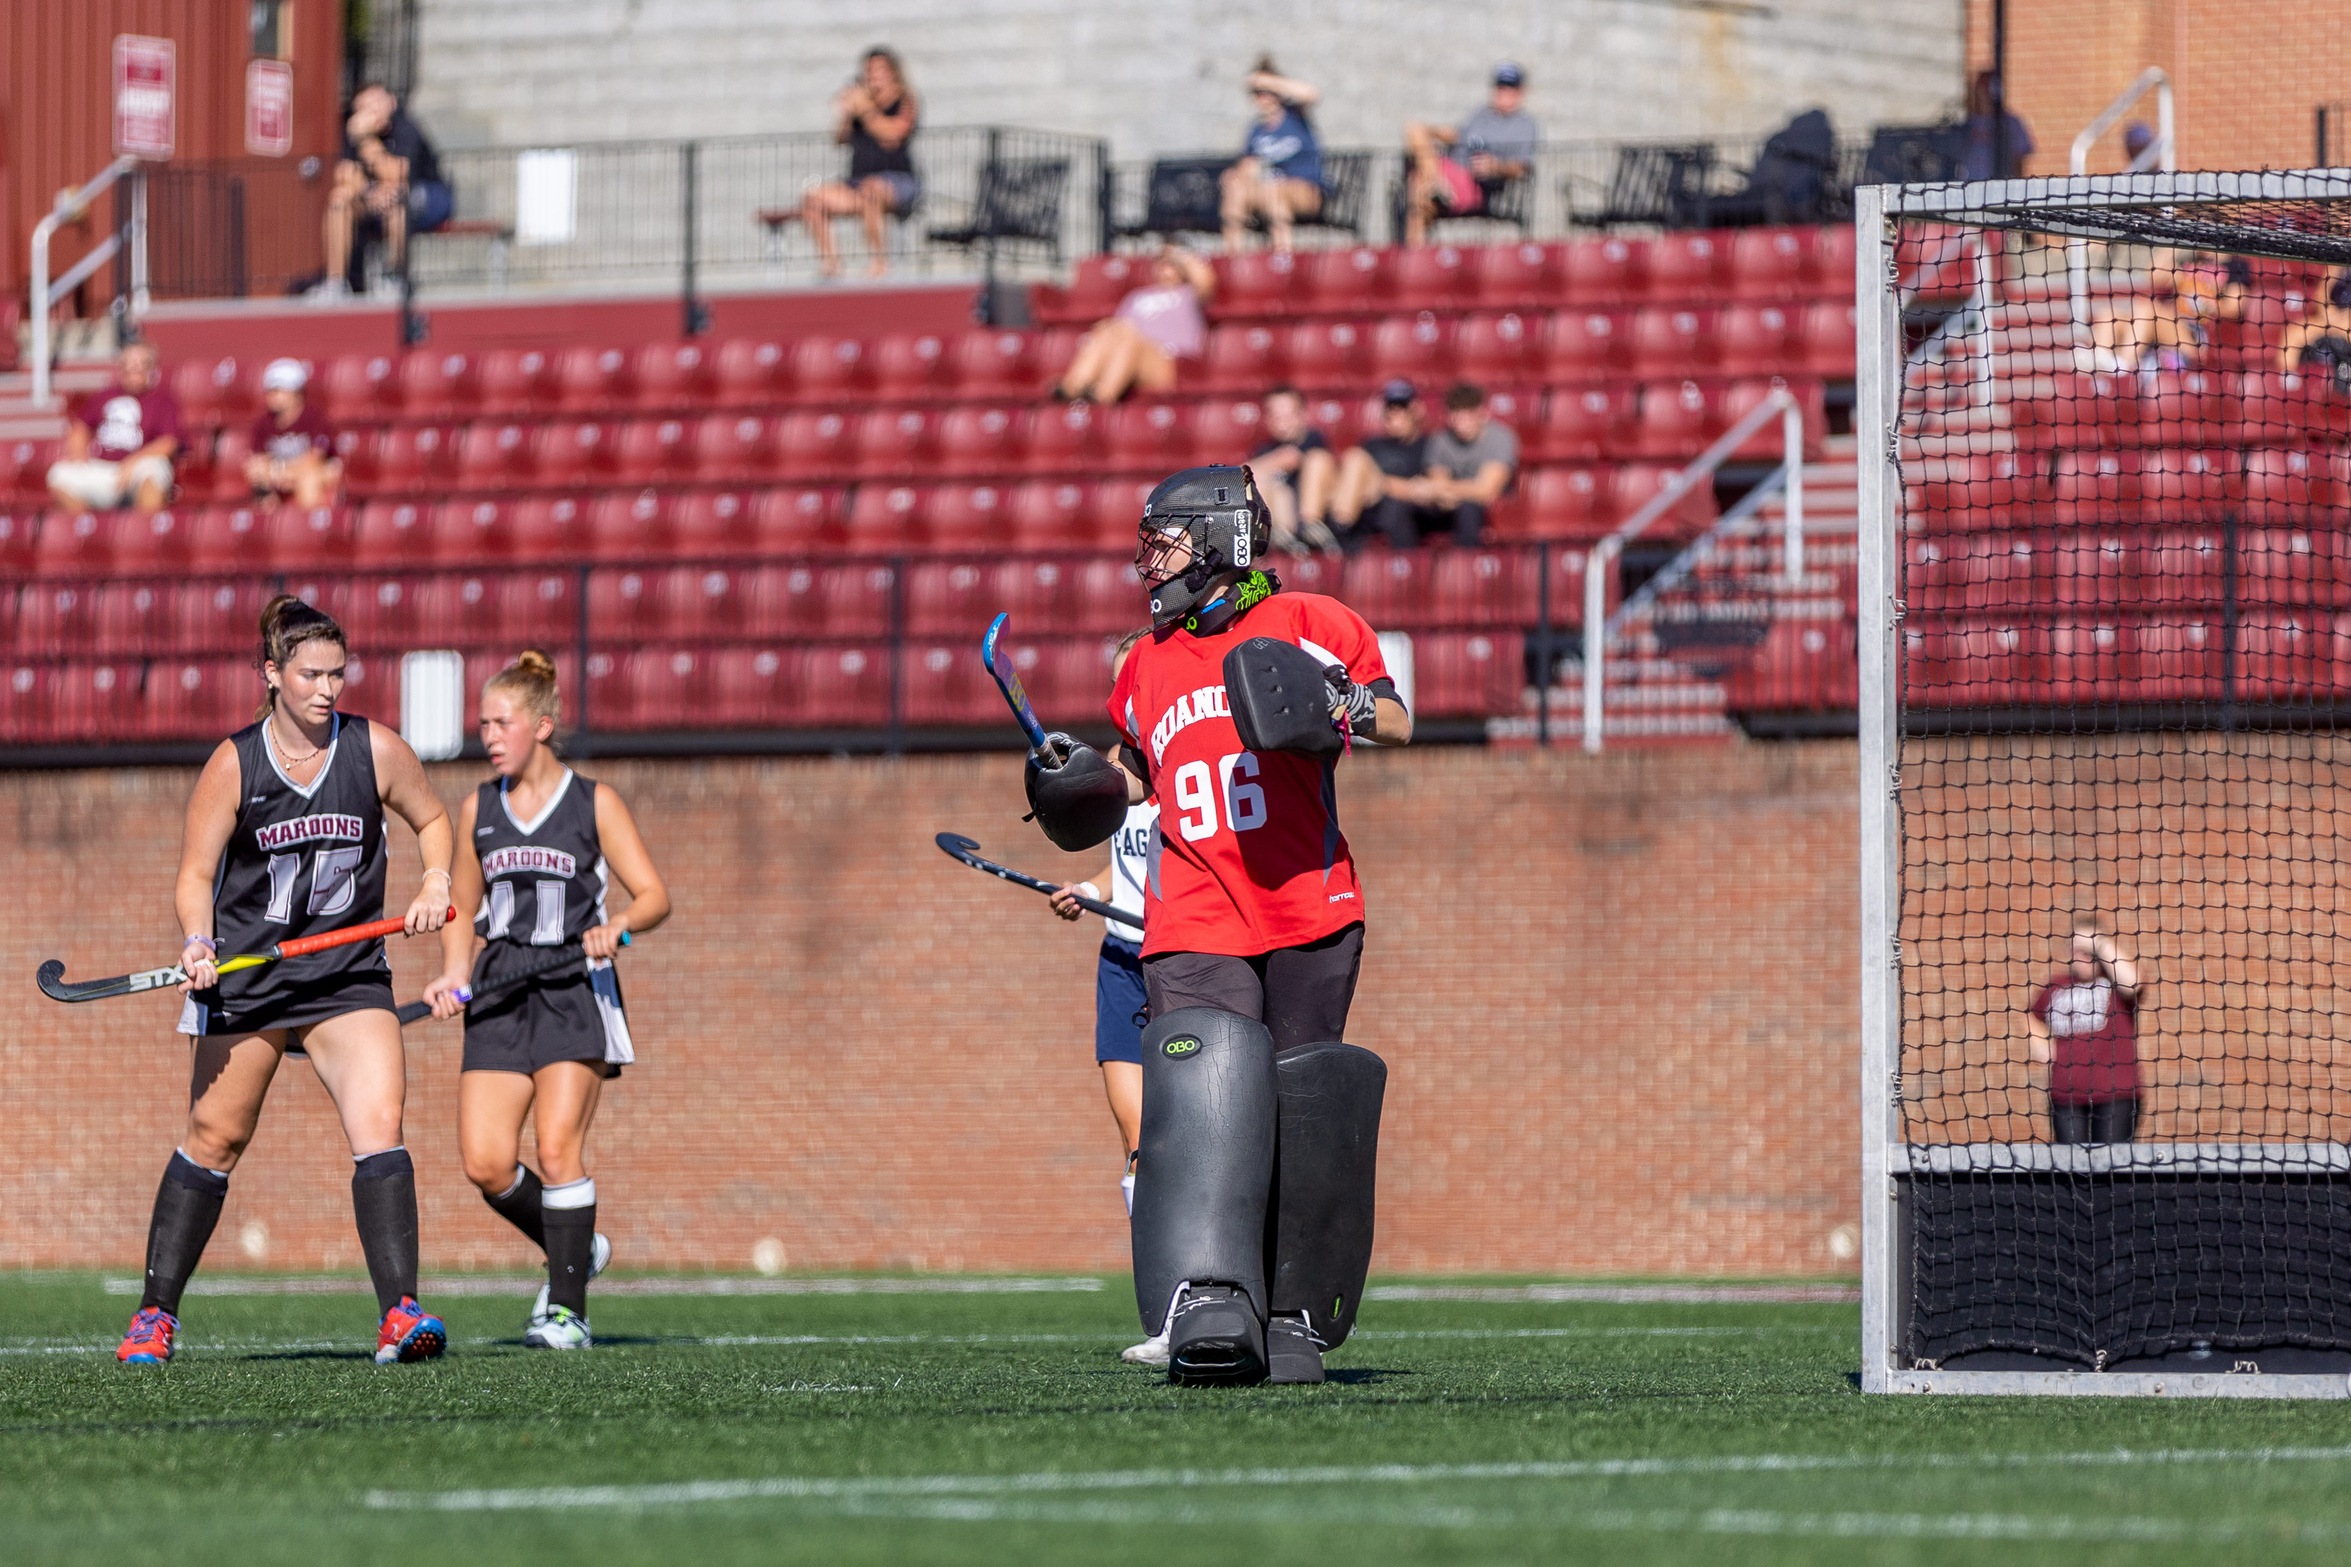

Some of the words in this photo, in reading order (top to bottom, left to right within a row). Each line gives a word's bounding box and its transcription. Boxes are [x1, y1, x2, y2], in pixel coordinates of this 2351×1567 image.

[1236, 538, 1248, 566] OBO
[1174, 751, 1268, 842] 96
[256, 813, 363, 851] MAROONS
[482, 845, 576, 882] MAROONS
[264, 845, 363, 925] 15
[487, 880, 567, 946] 11
[129, 964, 188, 992] STX
[1166, 1040, 1196, 1054] OBO
